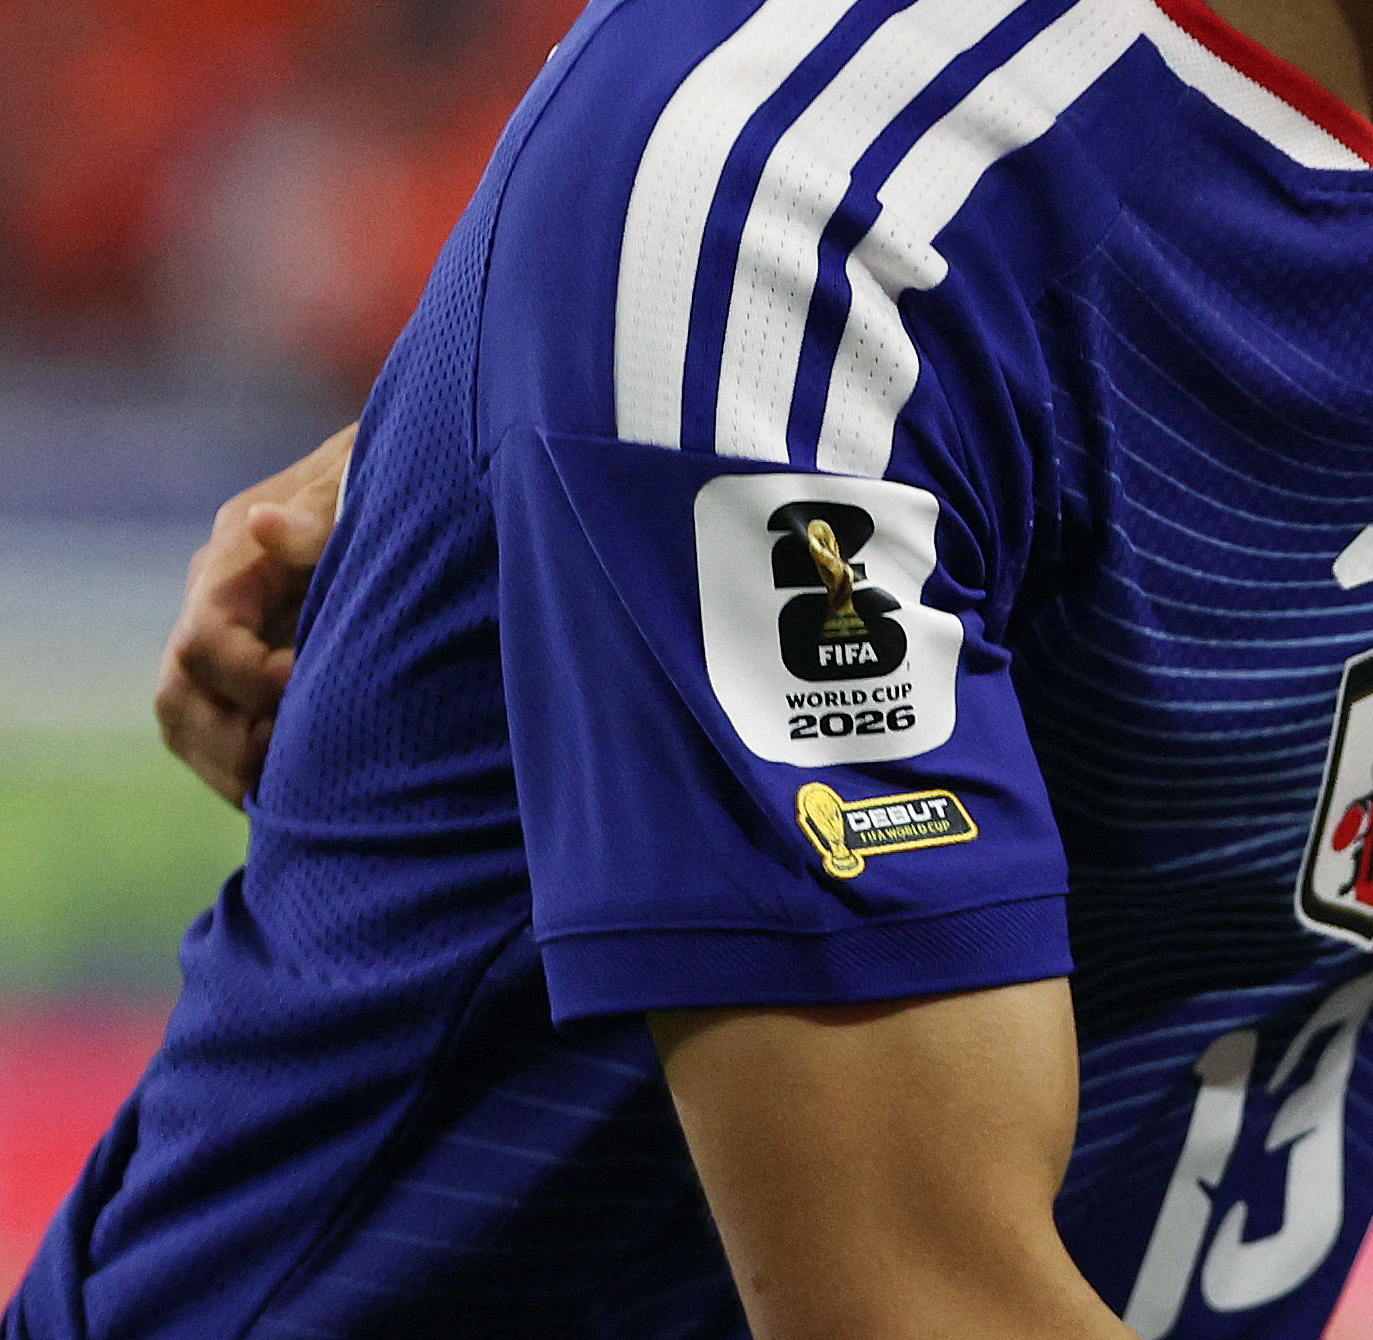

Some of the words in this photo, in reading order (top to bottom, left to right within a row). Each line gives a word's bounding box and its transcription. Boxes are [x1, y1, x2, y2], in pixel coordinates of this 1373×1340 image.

[818, 641, 878, 667] FIFA
[785, 689, 867, 709] WORLD
[871, 683, 913, 703] CUP
[788, 705, 916, 740] 2026
[847, 798, 948, 832] DEBUT
